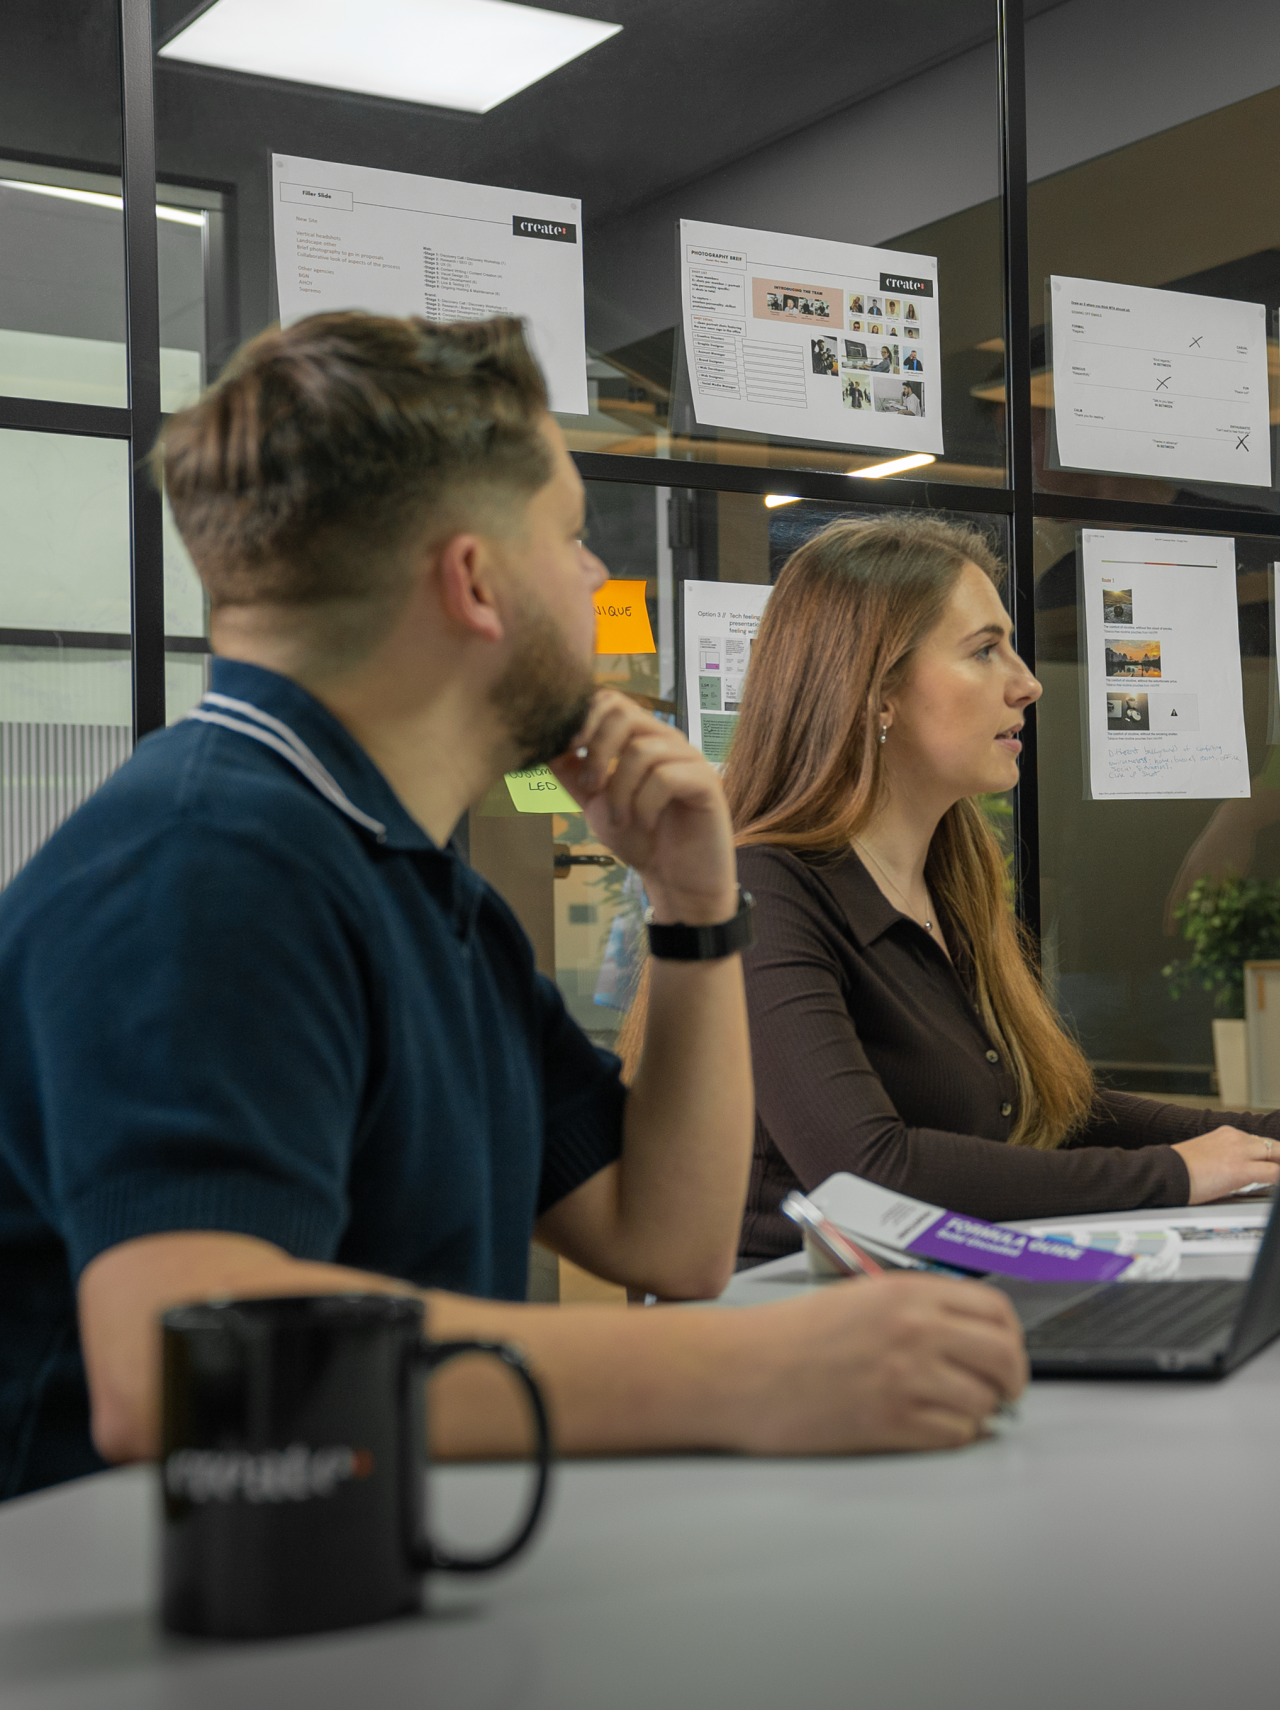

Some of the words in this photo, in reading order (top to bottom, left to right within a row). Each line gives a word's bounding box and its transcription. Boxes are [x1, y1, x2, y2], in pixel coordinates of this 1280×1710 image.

[316, 233, 341, 241] headshots
[297, 238, 322, 246] Landscape
[297, 251, 329, 260] Collaborative
[309, 246, 341, 256] photography
[691, 250, 728, 259] PHOTOGRAPHY
[594, 605, 632, 617] NIQUE
[729, 627, 747, 635] feeling
[528, 782, 557, 791] LED
